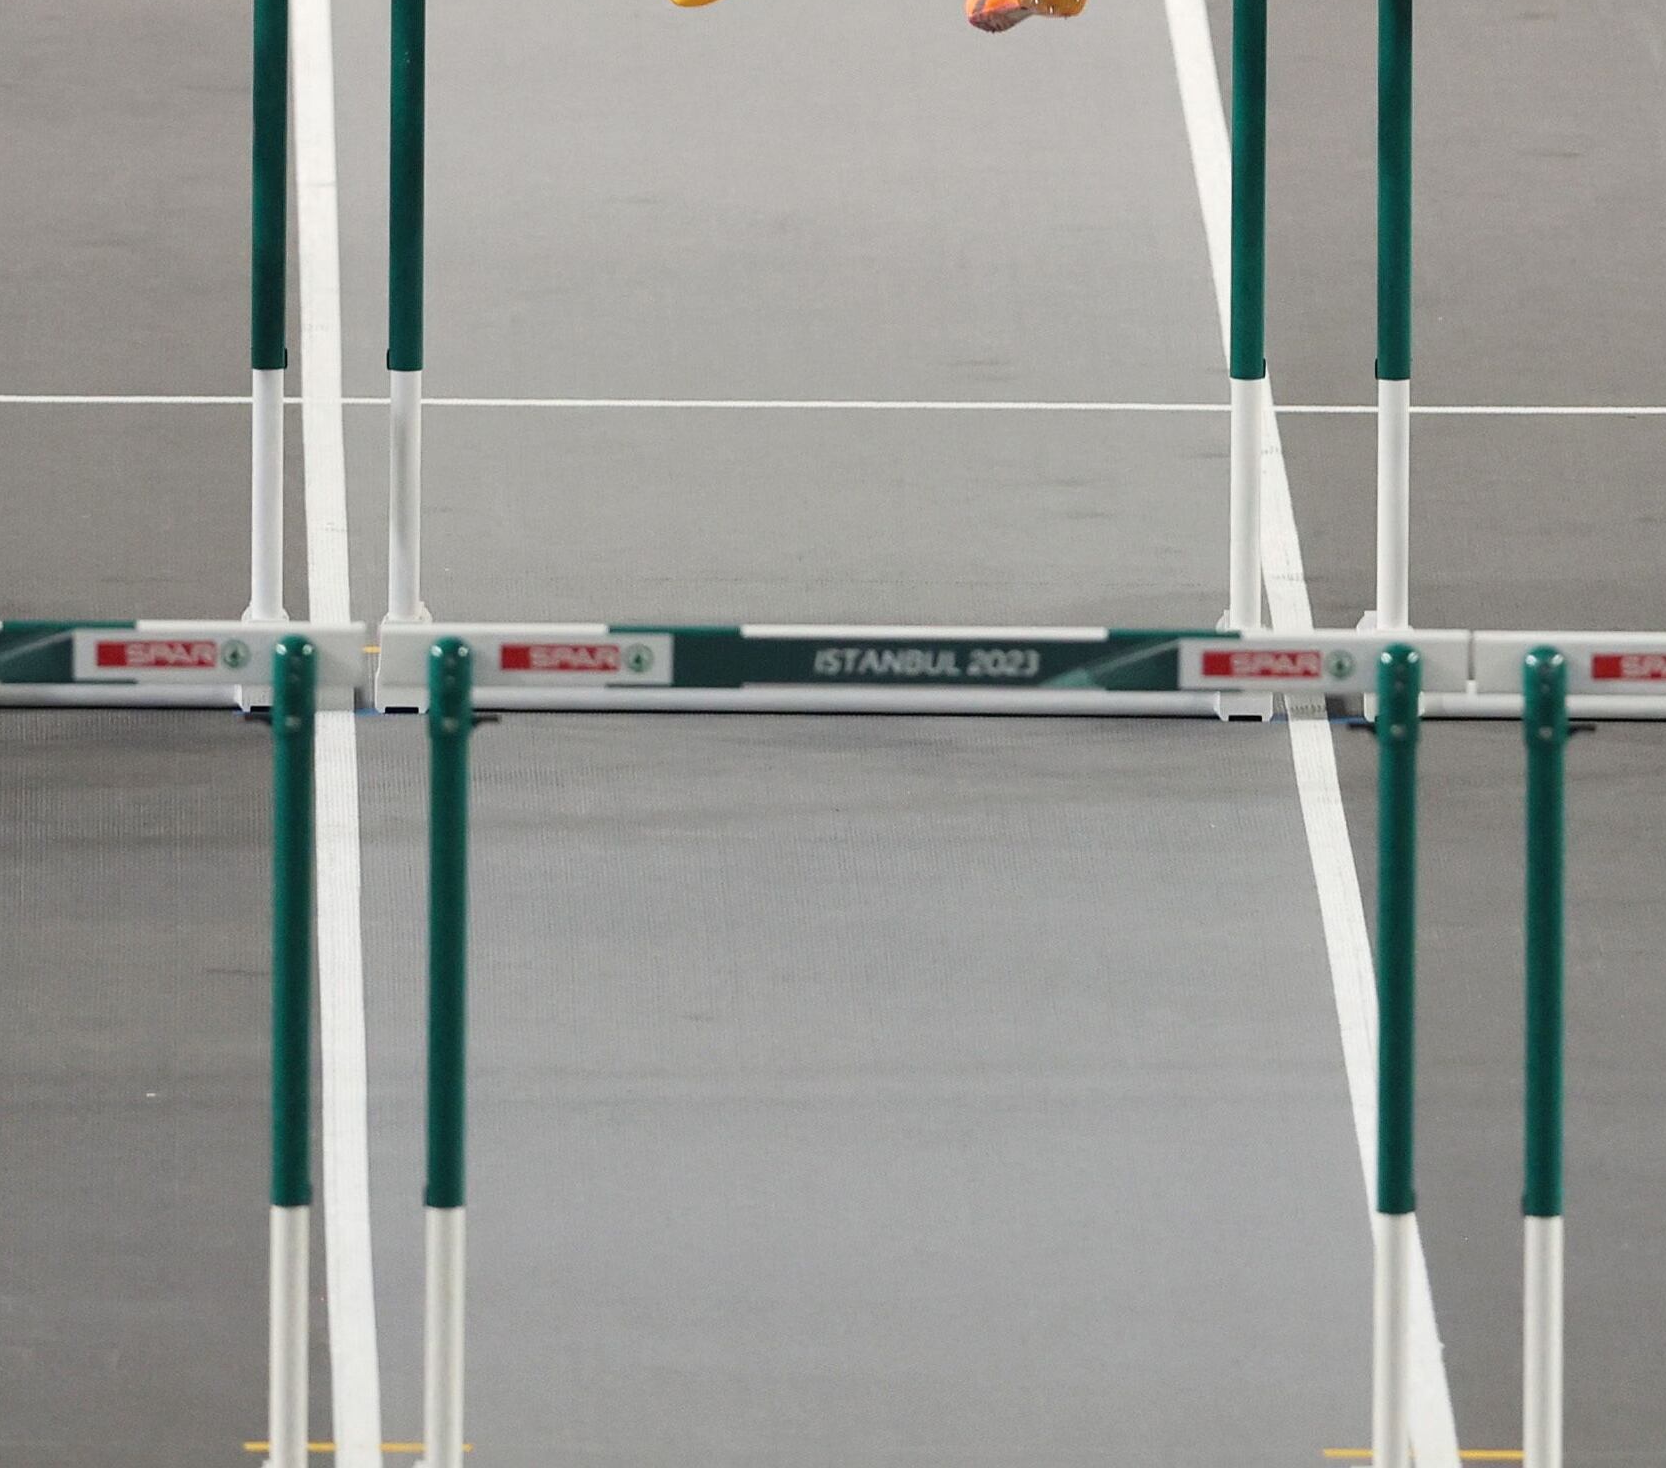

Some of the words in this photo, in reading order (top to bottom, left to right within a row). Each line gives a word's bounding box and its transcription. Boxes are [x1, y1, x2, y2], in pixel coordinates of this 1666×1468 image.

[127, 642, 216, 667] SPAR
[528, 645, 619, 670] SPAR
[813, 649, 960, 676] ISTANBUL
[967, 649, 1040, 677] 2023
[1230, 651, 1320, 676] SPAR
